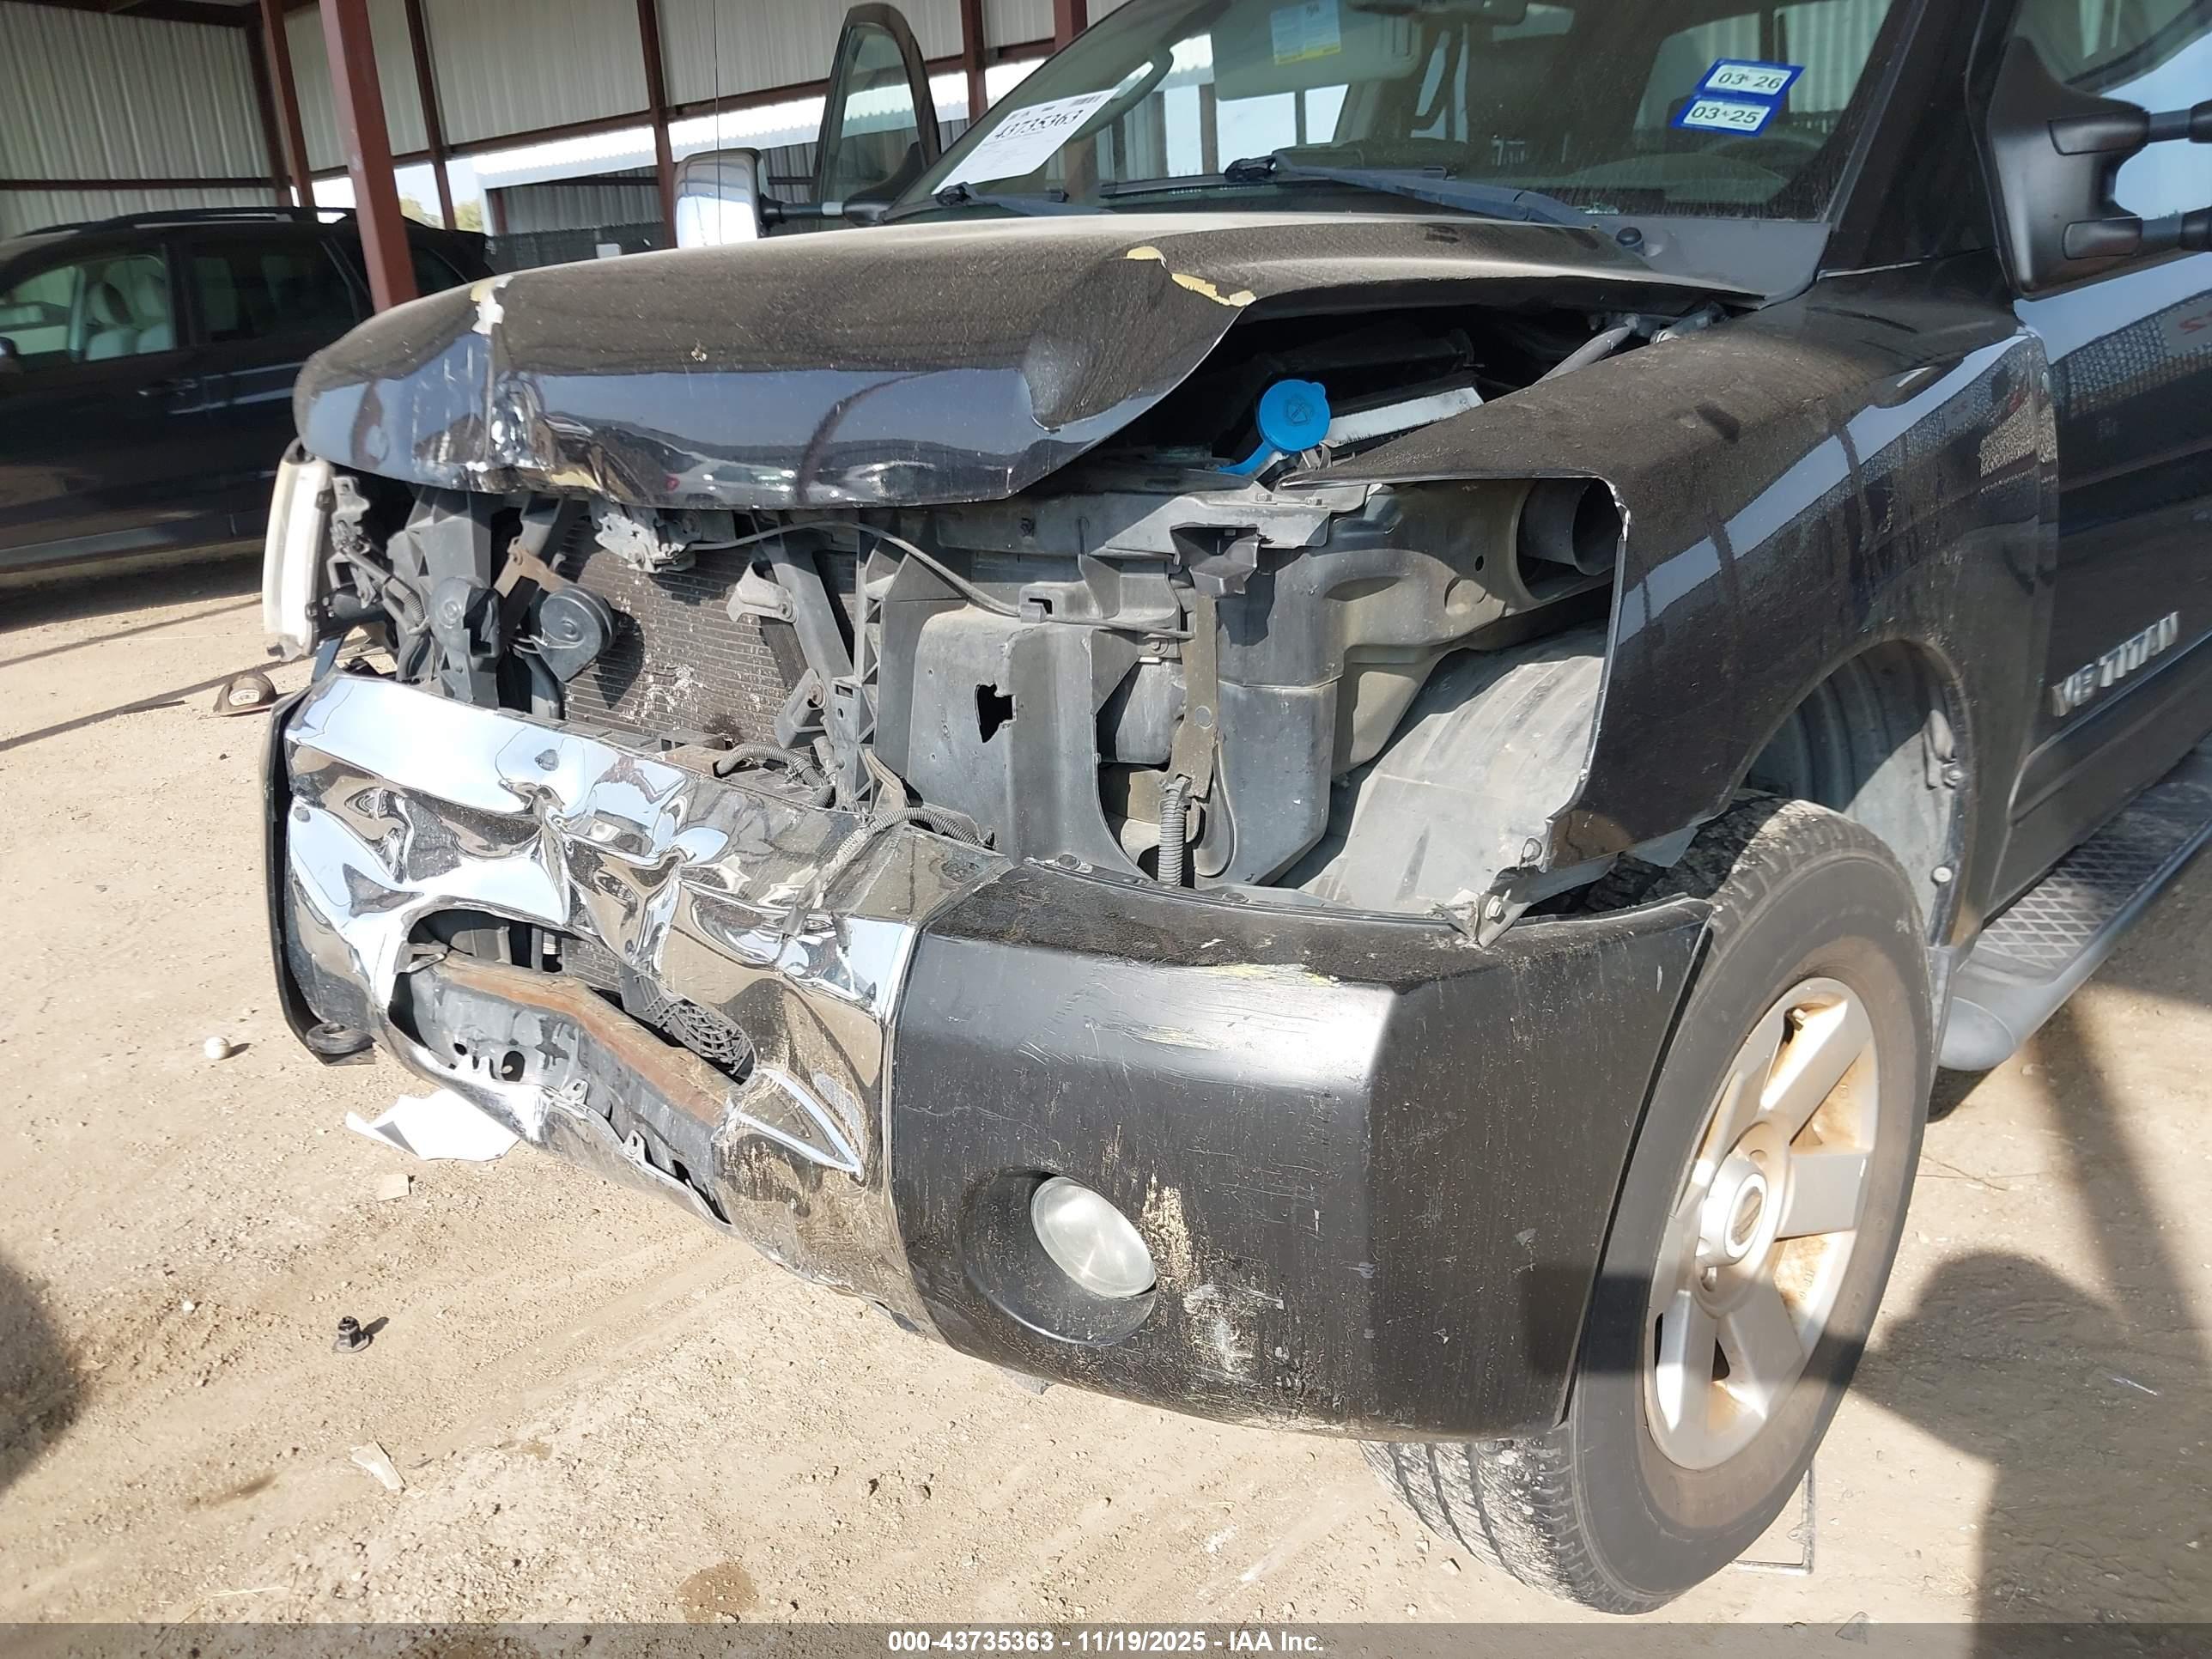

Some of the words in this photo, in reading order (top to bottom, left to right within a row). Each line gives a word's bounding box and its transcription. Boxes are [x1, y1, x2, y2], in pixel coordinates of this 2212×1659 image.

[1718, 72, 1745, 85] 03
[1753, 75, 1783, 89] 26
[994, 109, 1084, 139] 43735363
[1691, 106, 1720, 120] 03
[1729, 109, 1761, 125] 25
